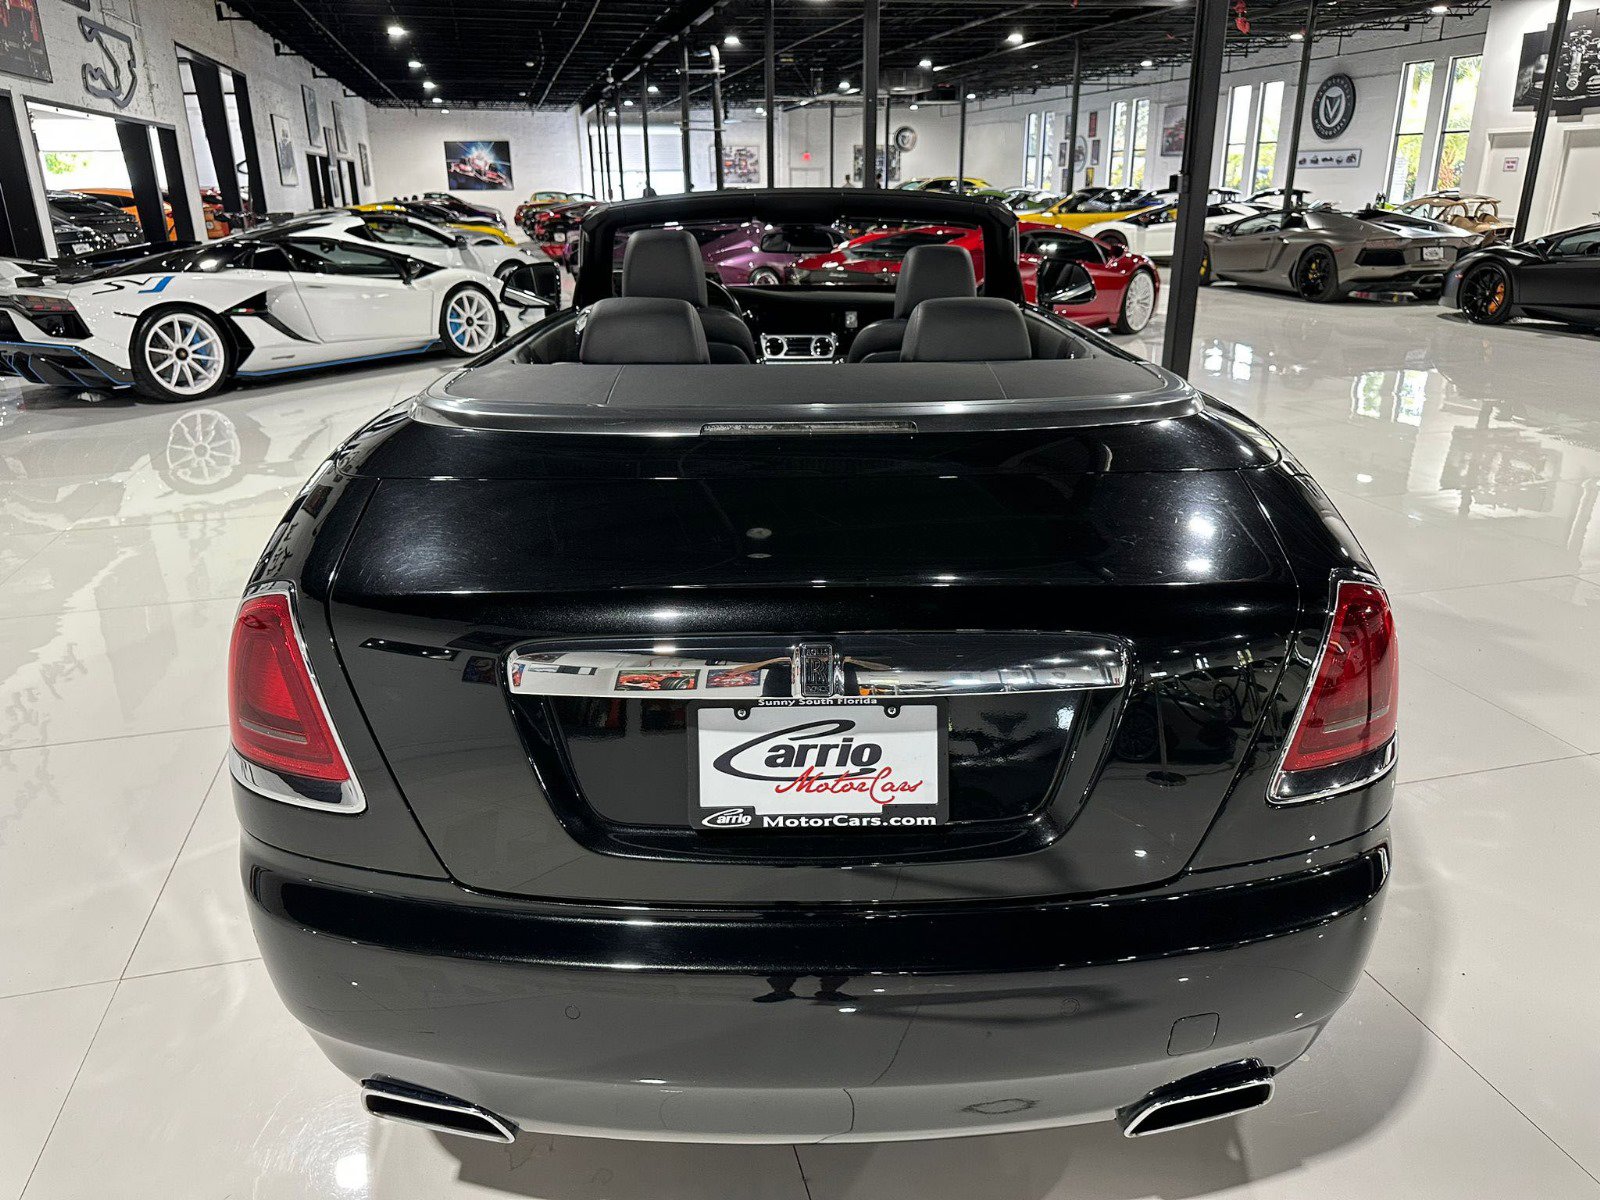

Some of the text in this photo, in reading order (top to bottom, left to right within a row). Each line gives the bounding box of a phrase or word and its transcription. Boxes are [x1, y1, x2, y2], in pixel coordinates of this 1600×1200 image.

[92, 275, 176, 295] SVJ
[758, 697, 877, 707] Sunny South Florida
[713, 719, 883, 782] Carrio
[701, 808, 937, 828] Carrio MotorCars.com
